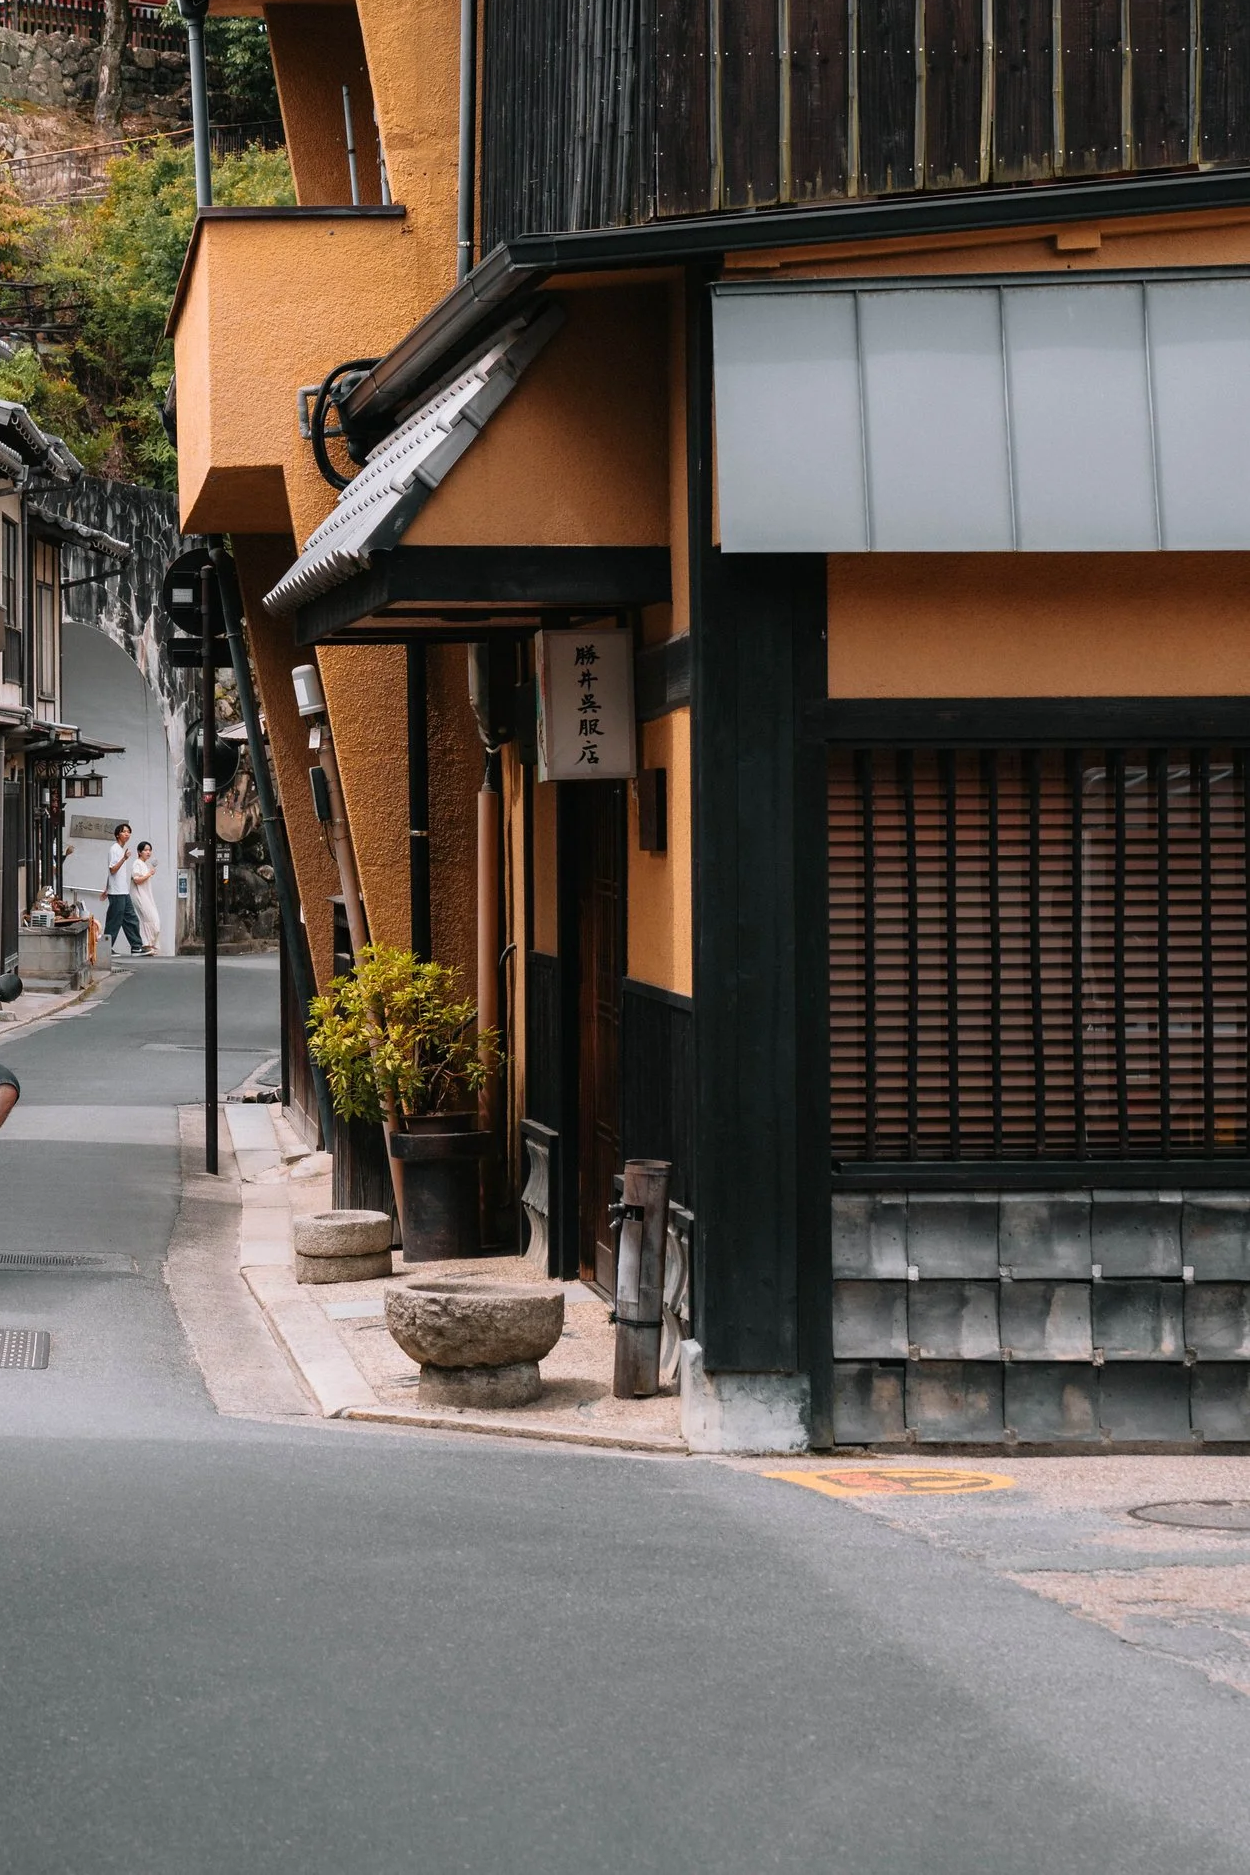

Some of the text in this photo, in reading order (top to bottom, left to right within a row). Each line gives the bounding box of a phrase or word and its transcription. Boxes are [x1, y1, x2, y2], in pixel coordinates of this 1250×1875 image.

[574, 644, 605, 765] 勝井呉服店
